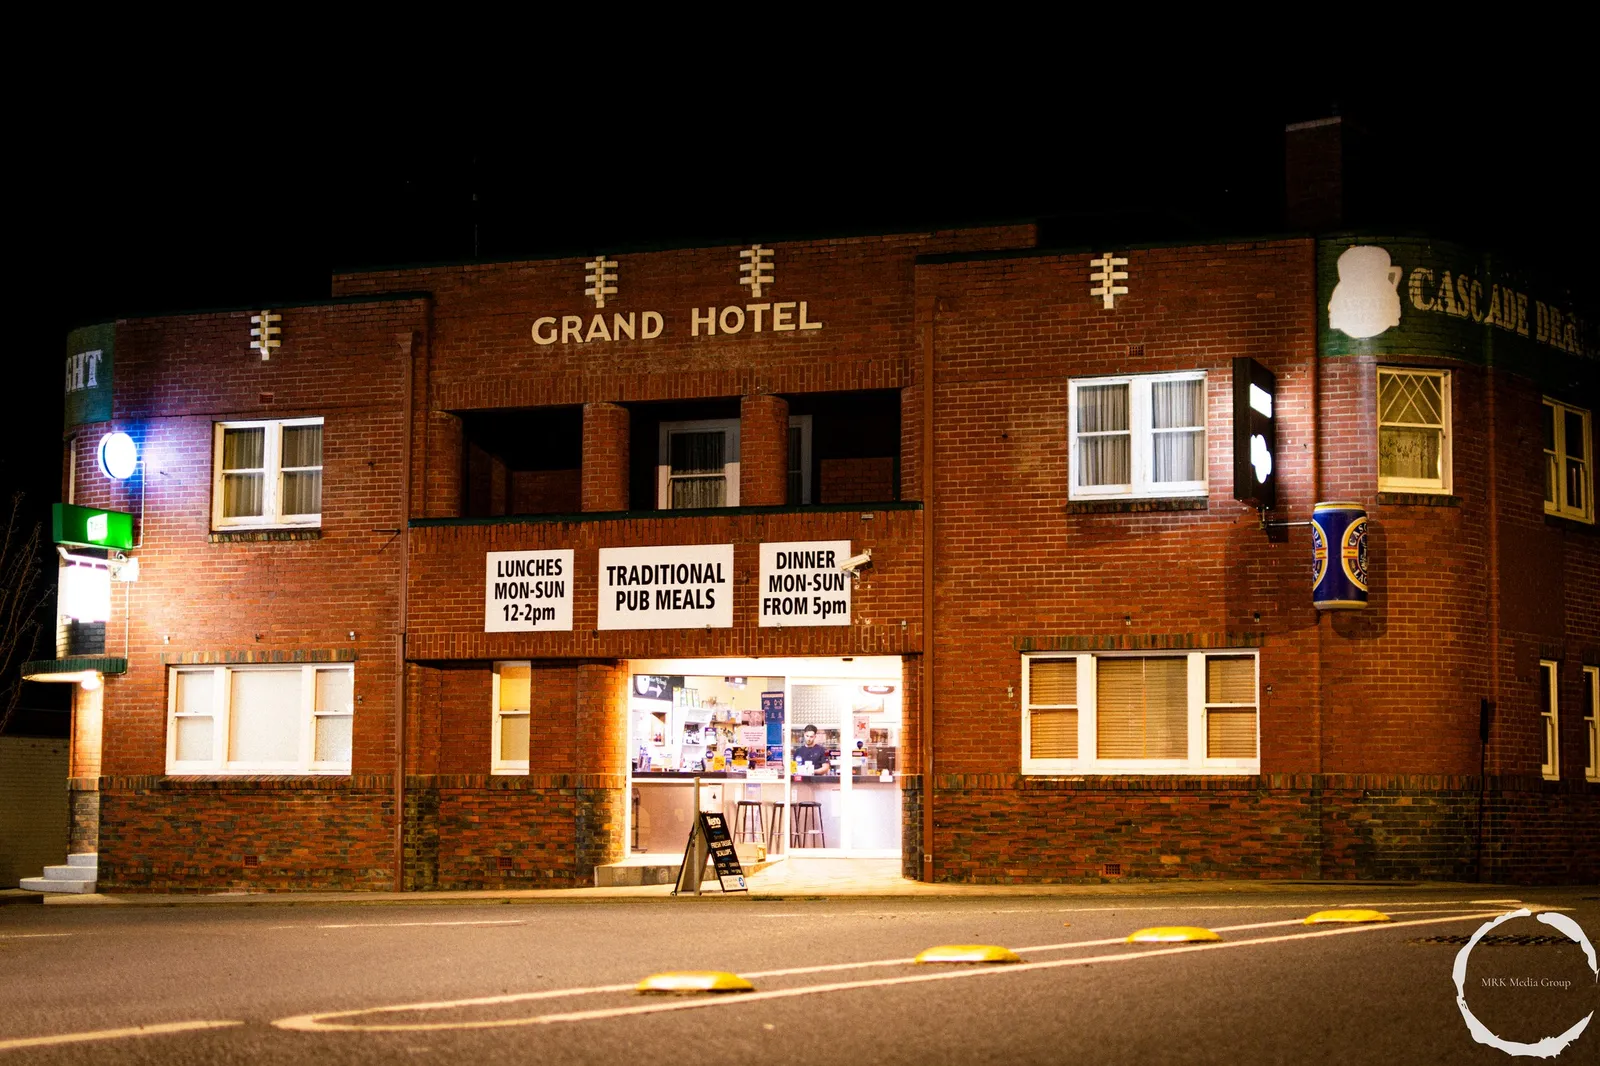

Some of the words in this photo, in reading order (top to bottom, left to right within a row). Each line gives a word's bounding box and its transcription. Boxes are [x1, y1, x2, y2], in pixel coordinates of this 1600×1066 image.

[1407, 267, 1530, 339] CASCADE
[531, 312, 664, 345] GRAND
[691, 301, 823, 337] HOTEL
[498, 559, 562, 577] LUNCHES
[776, 551, 836, 570] DINNER
[607, 563, 725, 586] TRADITIONAL
[769, 573, 845, 593] MON-SUN
[495, 581, 564, 599] MON-SUN
[616, 591, 649, 611] PUB
[656, 589, 715, 610] MEALS
[503, 604, 555, 625] 12-2pm
[764, 597, 809, 616] FROM
[813, 597, 846, 619] 5pm
